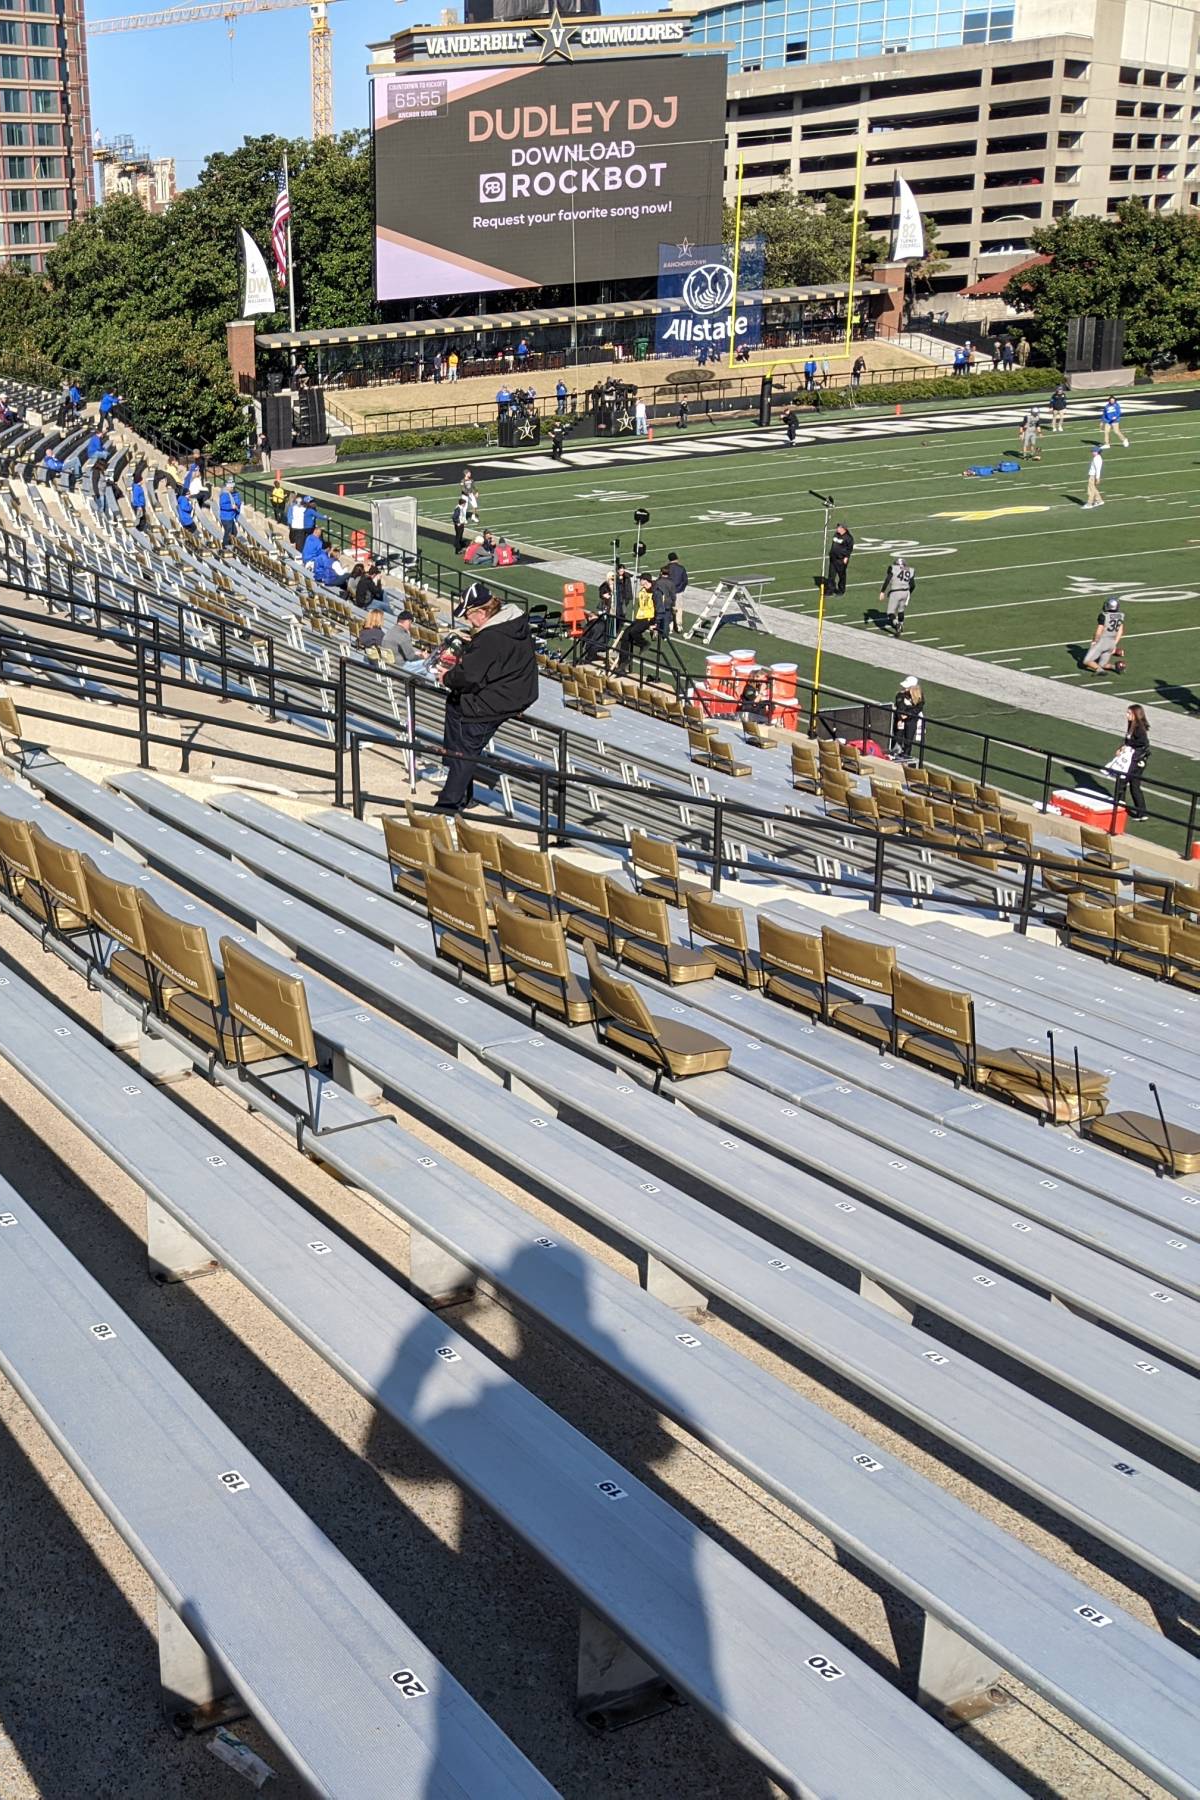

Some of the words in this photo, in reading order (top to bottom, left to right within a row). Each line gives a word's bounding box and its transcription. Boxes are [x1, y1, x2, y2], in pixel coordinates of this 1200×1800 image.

[426, 32, 526, 54] VANDERBILT
[551, 28, 565, 49] V
[581, 23, 684, 45] COMMODORES
[396, 90, 440, 108] 65:55
[468, 100, 620, 142] DUDLEY
[628, 96, 678, 130] DJ
[512, 140, 635, 166] DOWNLOAD
[512, 162, 668, 198] ROCKBOT
[473, 214, 524, 229] Request
[528, 212, 556, 226] your
[558, 206, 608, 221] favorite
[610, 206, 640, 220] song
[642, 201, 673, 214] now!
[249, 277, 268, 294] DW
[662, 316, 748, 340] Allstate
[574, 489, 650, 502] 10
[690, 510, 783, 526] 20
[853, 537, 958, 558] 30
[897, 570, 910, 582] 49
[1062, 574, 1200, 602] 40
[234, 1002, 293, 1048] www.vandyseats.com
[901, 1008, 958, 1036] www.vandyseats.com
[125, 1086, 140, 1094] 15
[208, 1156, 225, 1165] 16
[419, 1158, 436, 1166] 15
[642, 1184, 659, 1192] 15
[837, 1203, 854, 1212] 15
[1014, 1223, 1030, 1231] 15
[309, 1242, 330, 1252] 17
[536, 1238, 556, 1247] 16
[769, 1260, 789, 1271] 16
[974, 1277, 994, 1286] 16
[1152, 1292, 1172, 1300] 16
[92, 1324, 114, 1339] 18
[678, 1335, 700, 1346] 17
[437, 1348, 459, 1361] 18
[924, 1353, 947, 1364] 17
[1135, 1362, 1158, 1373] 17
[855, 1456, 881, 1470] 18
[1114, 1462, 1139, 1475] 18
[221, 1472, 247, 1491] 19
[598, 1482, 626, 1498] 19
[1077, 1607, 1109, 1626] 19
[808, 1656, 841, 1678] 20
[393, 1671, 426, 1696] 20
